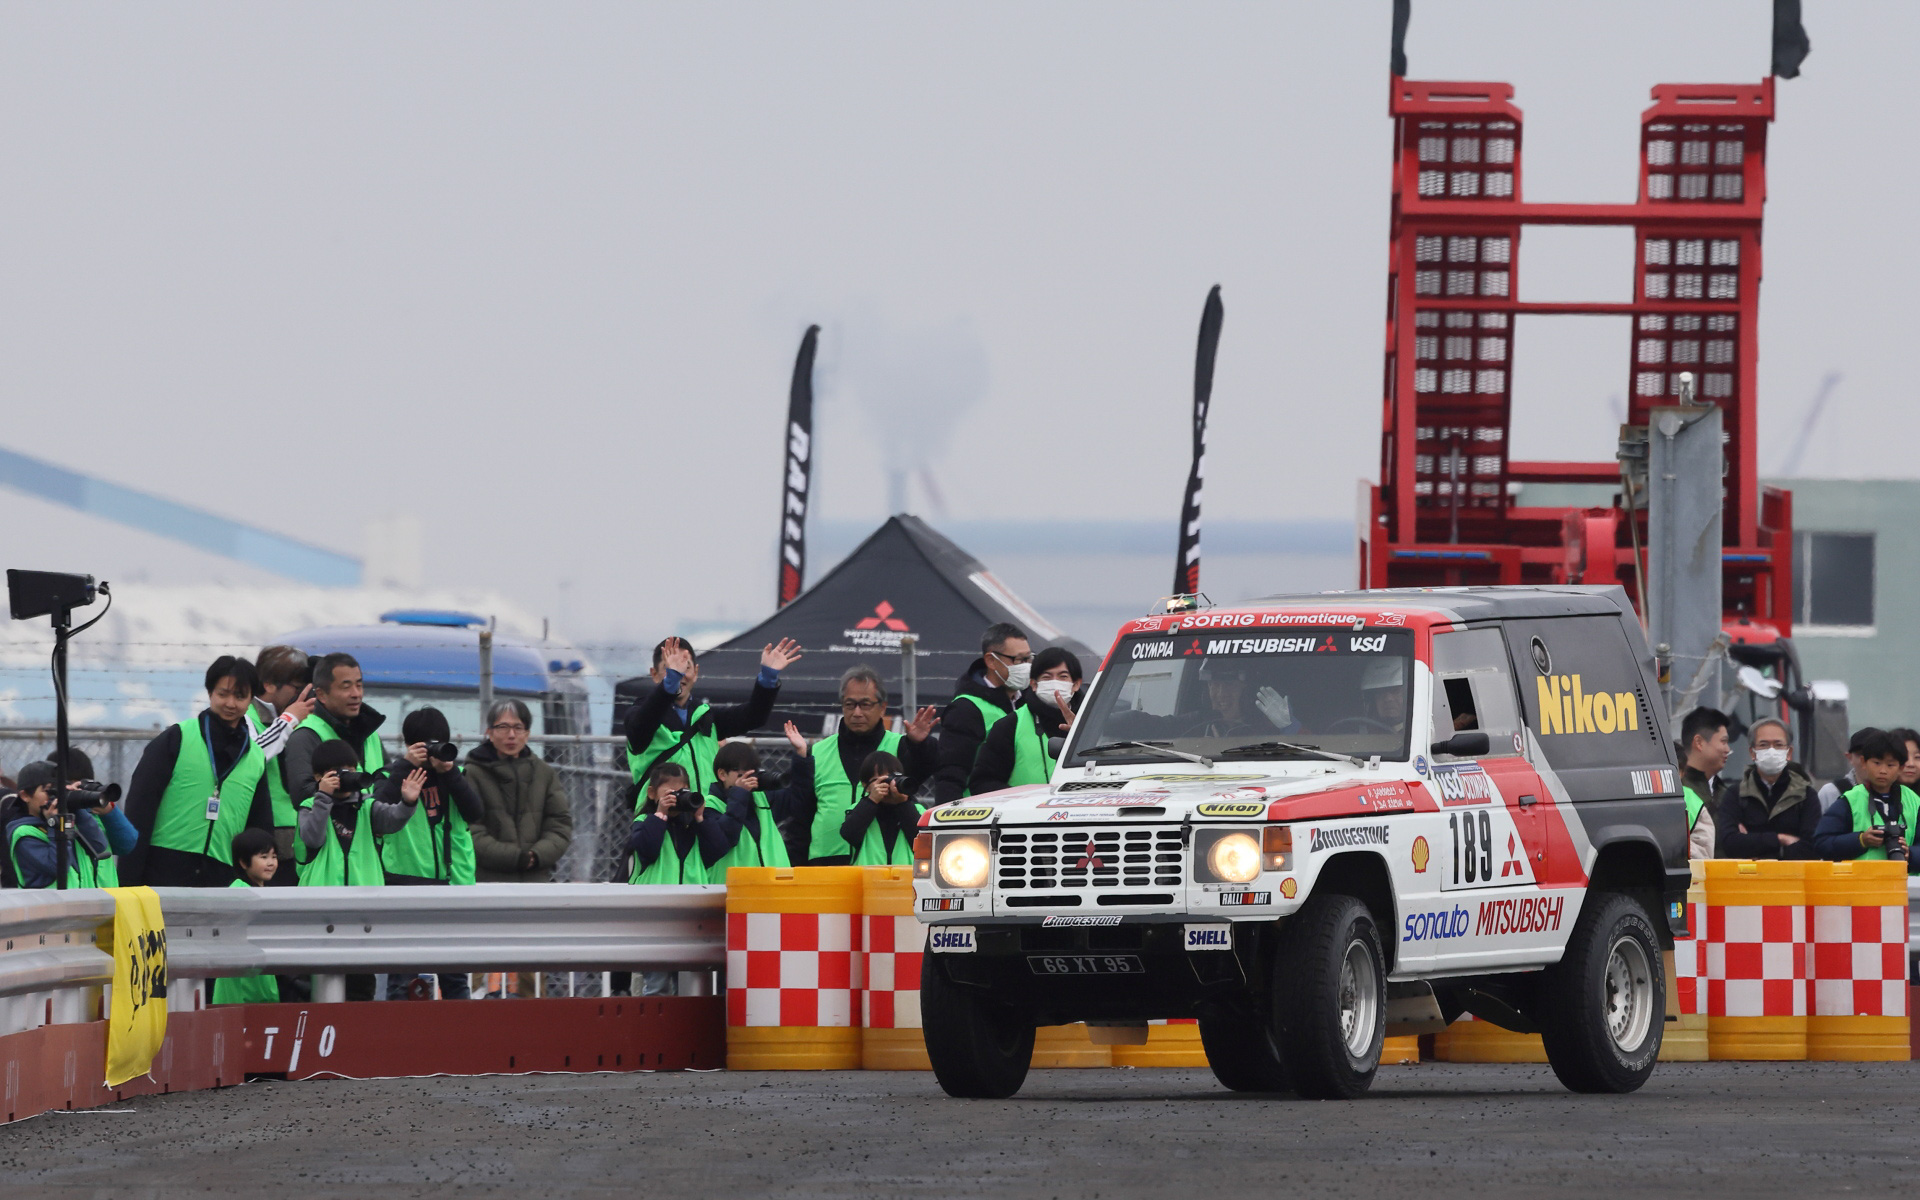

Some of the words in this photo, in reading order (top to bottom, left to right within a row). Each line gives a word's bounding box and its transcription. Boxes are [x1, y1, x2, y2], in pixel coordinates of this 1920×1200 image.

[1182, 614, 1255, 628] SOFRIG
[1261, 613, 1357, 625] Informatique
[1132, 641, 1174, 659] OLYMPIA
[1207, 638, 1316, 654] MITSUBISHI
[1350, 634, 1387, 652] vsd
[1537, 674, 1638, 735] Nikon
[941, 808, 987, 817] Nikon
[1205, 804, 1258, 812] Nikon
[1310, 825, 1389, 853] BRIDGESTONE
[1449, 810, 1493, 884] 189
[1043, 916, 1121, 927] BRIDGESTONE
[1403, 904, 1469, 942] sonauto
[1475, 896, 1564, 936] MITSUBISHI
[933, 932, 972, 948] SHELL
[1188, 930, 1228, 945] SHELL
[1043, 957, 1069, 973] 66
[1073, 957, 1097, 973] XT
[1104, 957, 1131, 972] 95
